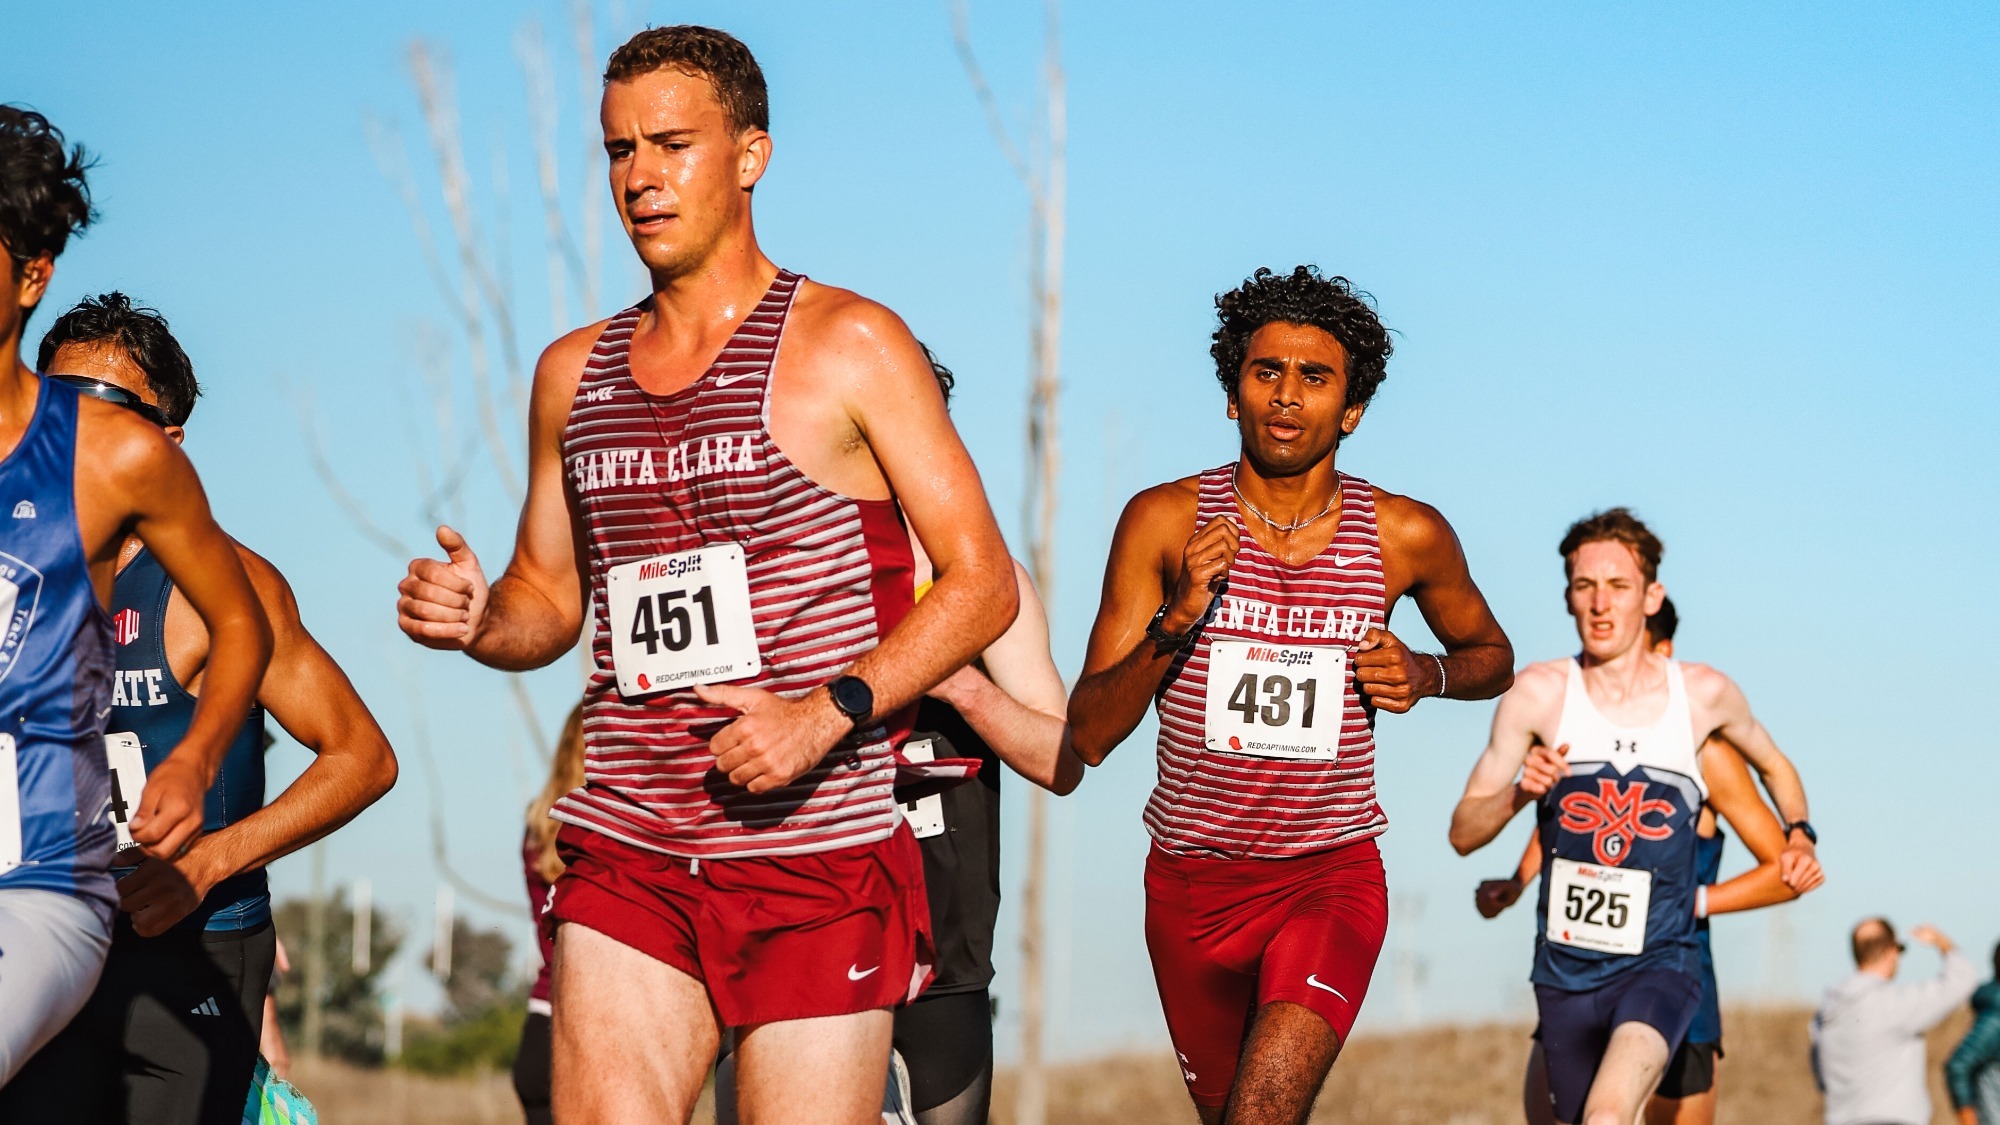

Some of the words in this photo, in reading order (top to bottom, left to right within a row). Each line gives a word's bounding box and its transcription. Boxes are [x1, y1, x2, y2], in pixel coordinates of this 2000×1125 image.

[575, 448, 658, 493] SANTA
[668, 434, 757, 482] CLARA
[638, 554, 702, 582] MileSplit
[631, 585, 719, 655] 451
[1206, 598, 1280, 637] ANTA
[655, 664, 734, 684] REDCAPTIMING.COM
[1246, 646, 1313, 667] MileSplit
[111, 668, 168, 707] ATE
[1227, 672, 1316, 729] 431
[1246, 741, 1317, 754] REDCAPTIMING.COM
[1558, 778, 1677, 867] SMC
[1565, 883, 1630, 929] 525
